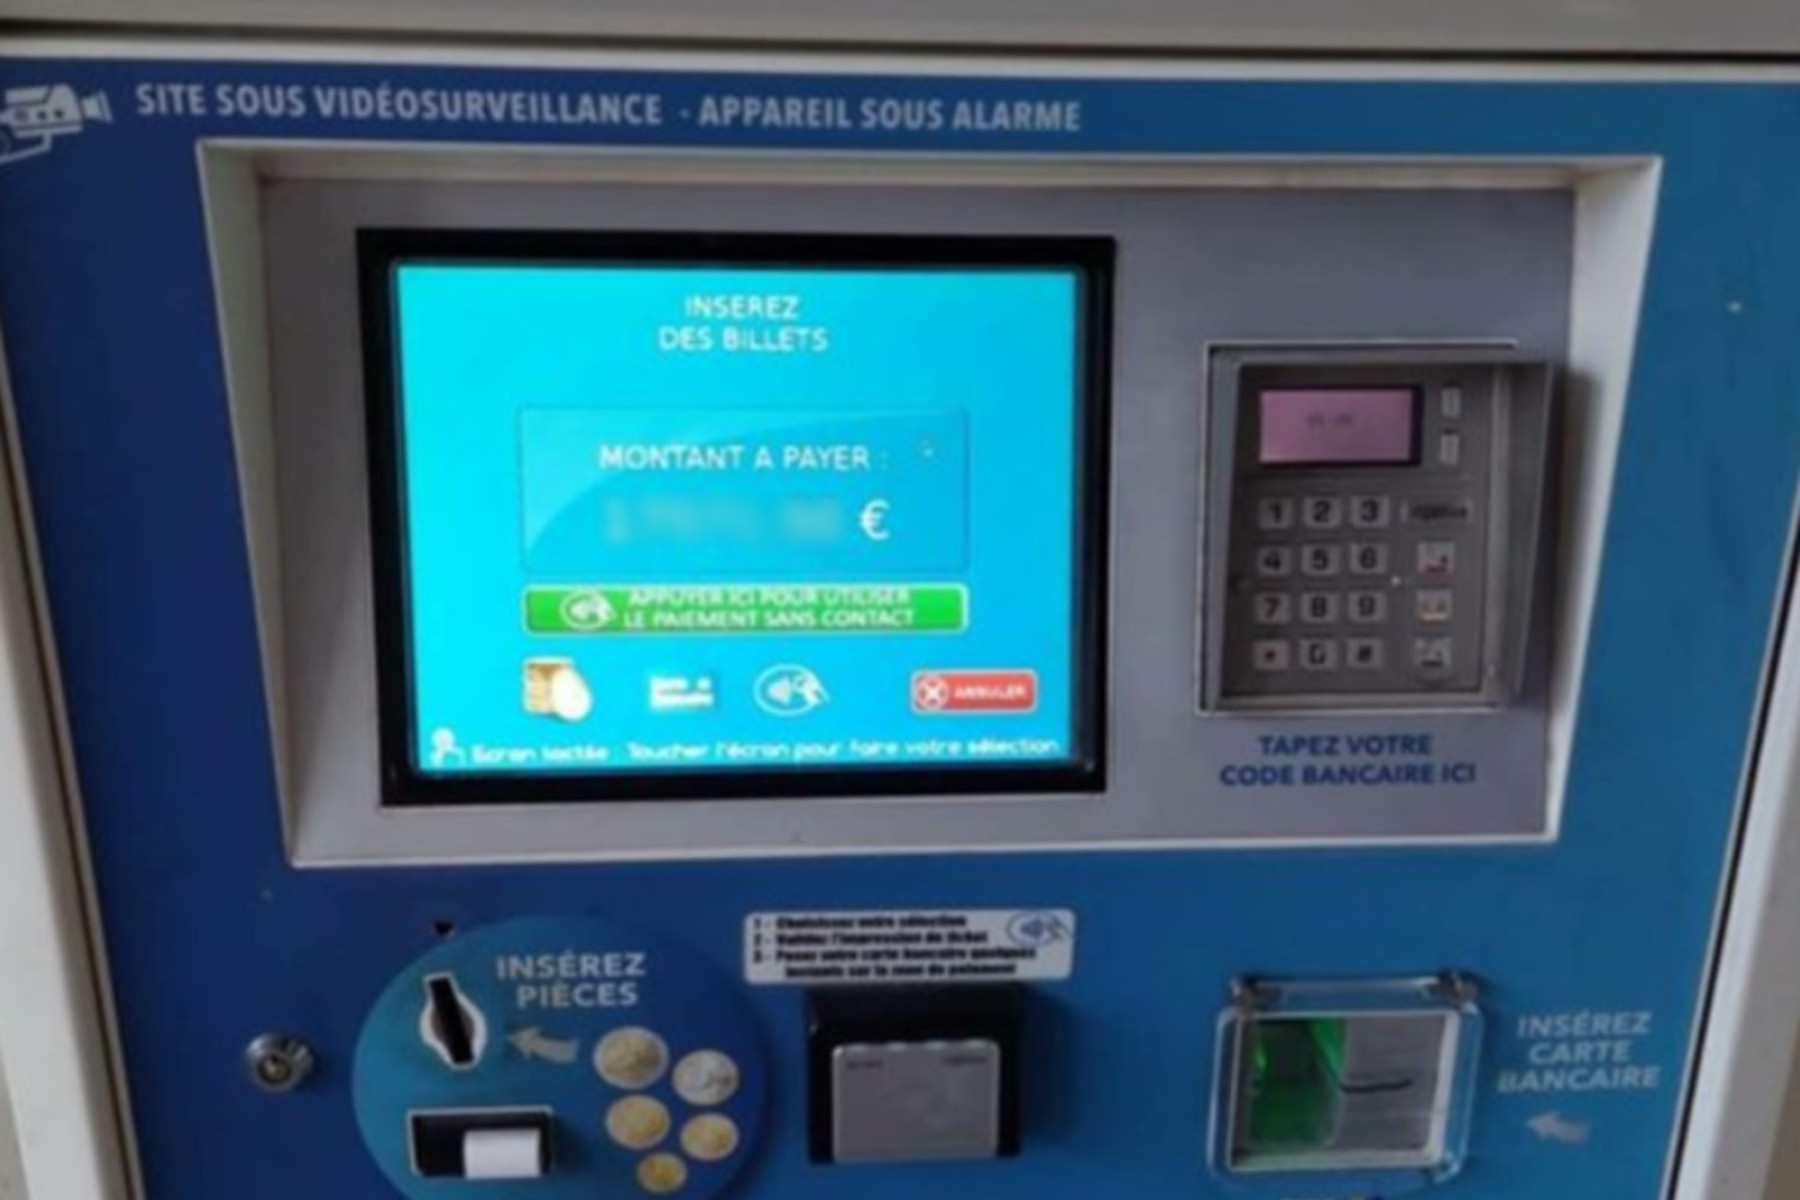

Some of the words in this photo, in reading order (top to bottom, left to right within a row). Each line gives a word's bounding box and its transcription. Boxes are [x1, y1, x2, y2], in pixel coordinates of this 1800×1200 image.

[136, 83, 207, 116] SITE
[216, 85, 302, 118] SOUS
[313, 83, 663, 125] VIDÉOSURVEILLANCE
[700, 96, 852, 129] APPAREIL
[861, 98, 944, 131] SOUS
[952, 100, 1081, 133] ALARME
[684, 296, 800, 320] INSEREZ
[658, 326, 714, 352] DES
[723, 326, 829, 352] BILLETS
[600, 445, 745, 471] MONTANT
[754, 445, 773, 470] A
[783, 445, 870, 470] PAYER
[1313, 502, 1331, 522] 2
[1360, 501, 1379, 522] 3
[1263, 551, 1282, 570] 4
[1312, 550, 1329, 570] 5
[1359, 548, 1377, 569] 6
[624, 609, 645, 628] LE
[653, 609, 757, 628] PAIEMENT
[765, 609, 816, 628] SANS
[821, 608, 915, 627] CONTACT
[1262, 599, 1280, 620] 7
[1311, 597, 1328, 618] 8
[1358, 597, 1376, 618] 9
[1258, 735, 1341, 757] TAPEZ
[1346, 734, 1434, 757] VOTRE
[1219, 765, 1295, 786] CODE
[1302, 764, 1434, 786] BANCAIRE
[1442, 763, 1476, 784] ICI
[496, 949, 648, 980] INSÉREZ
[516, 979, 639, 1008] PIÈCES
[1517, 1010, 1652, 1038] INSÉREZ
[1528, 1039, 1633, 1065] CARTE
[1496, 1065, 1661, 1093] BANCAIRE
